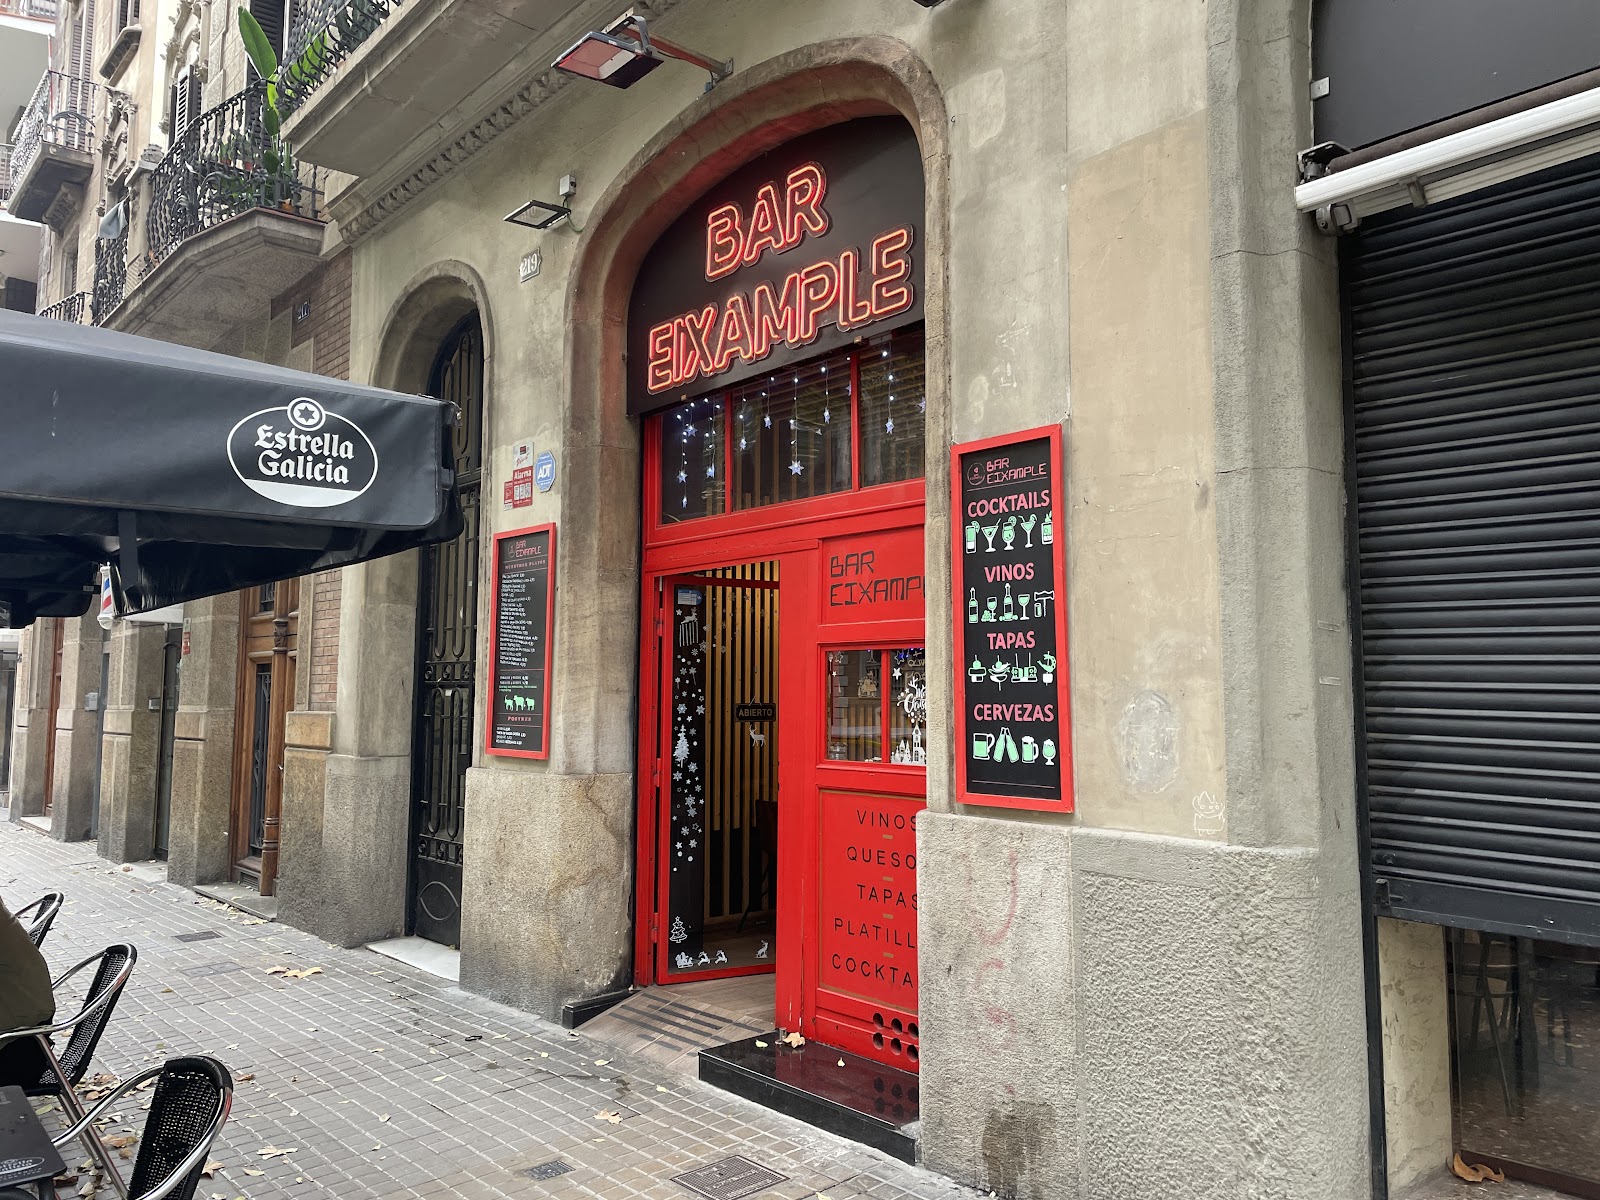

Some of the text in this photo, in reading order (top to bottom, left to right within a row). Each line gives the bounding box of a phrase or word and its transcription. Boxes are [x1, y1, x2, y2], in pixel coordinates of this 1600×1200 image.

[706, 163, 827, 279] BAR
[520, 253, 538, 277] 219
[648, 227, 911, 392] EIXAMPLE
[254, 424, 355, 460] Estrella
[258, 449, 350, 485] Galicia
[513, 469, 532, 480] Alarma
[537, 464, 552, 480] ADT
[986, 457, 1010, 472] BAR
[986, 462, 1047, 485] EIXAMPLE
[967, 489, 1050, 518] COCKTAILS
[515, 540, 527, 549] BAR
[830, 550, 875, 578] BAR
[984, 562, 1035, 583] VINOS
[830, 575, 926, 607] EIXAMP
[987, 630, 1036, 650] TAPAS
[738, 707, 773, 718] ABIERTO
[973, 703, 1055, 722] CERVEZAS
[856, 809, 917, 831] VINOS
[856, 884, 918, 911] TAPAS
[834, 918, 916, 949] PLATILL
[831, 953, 914, 989] COCKTA
